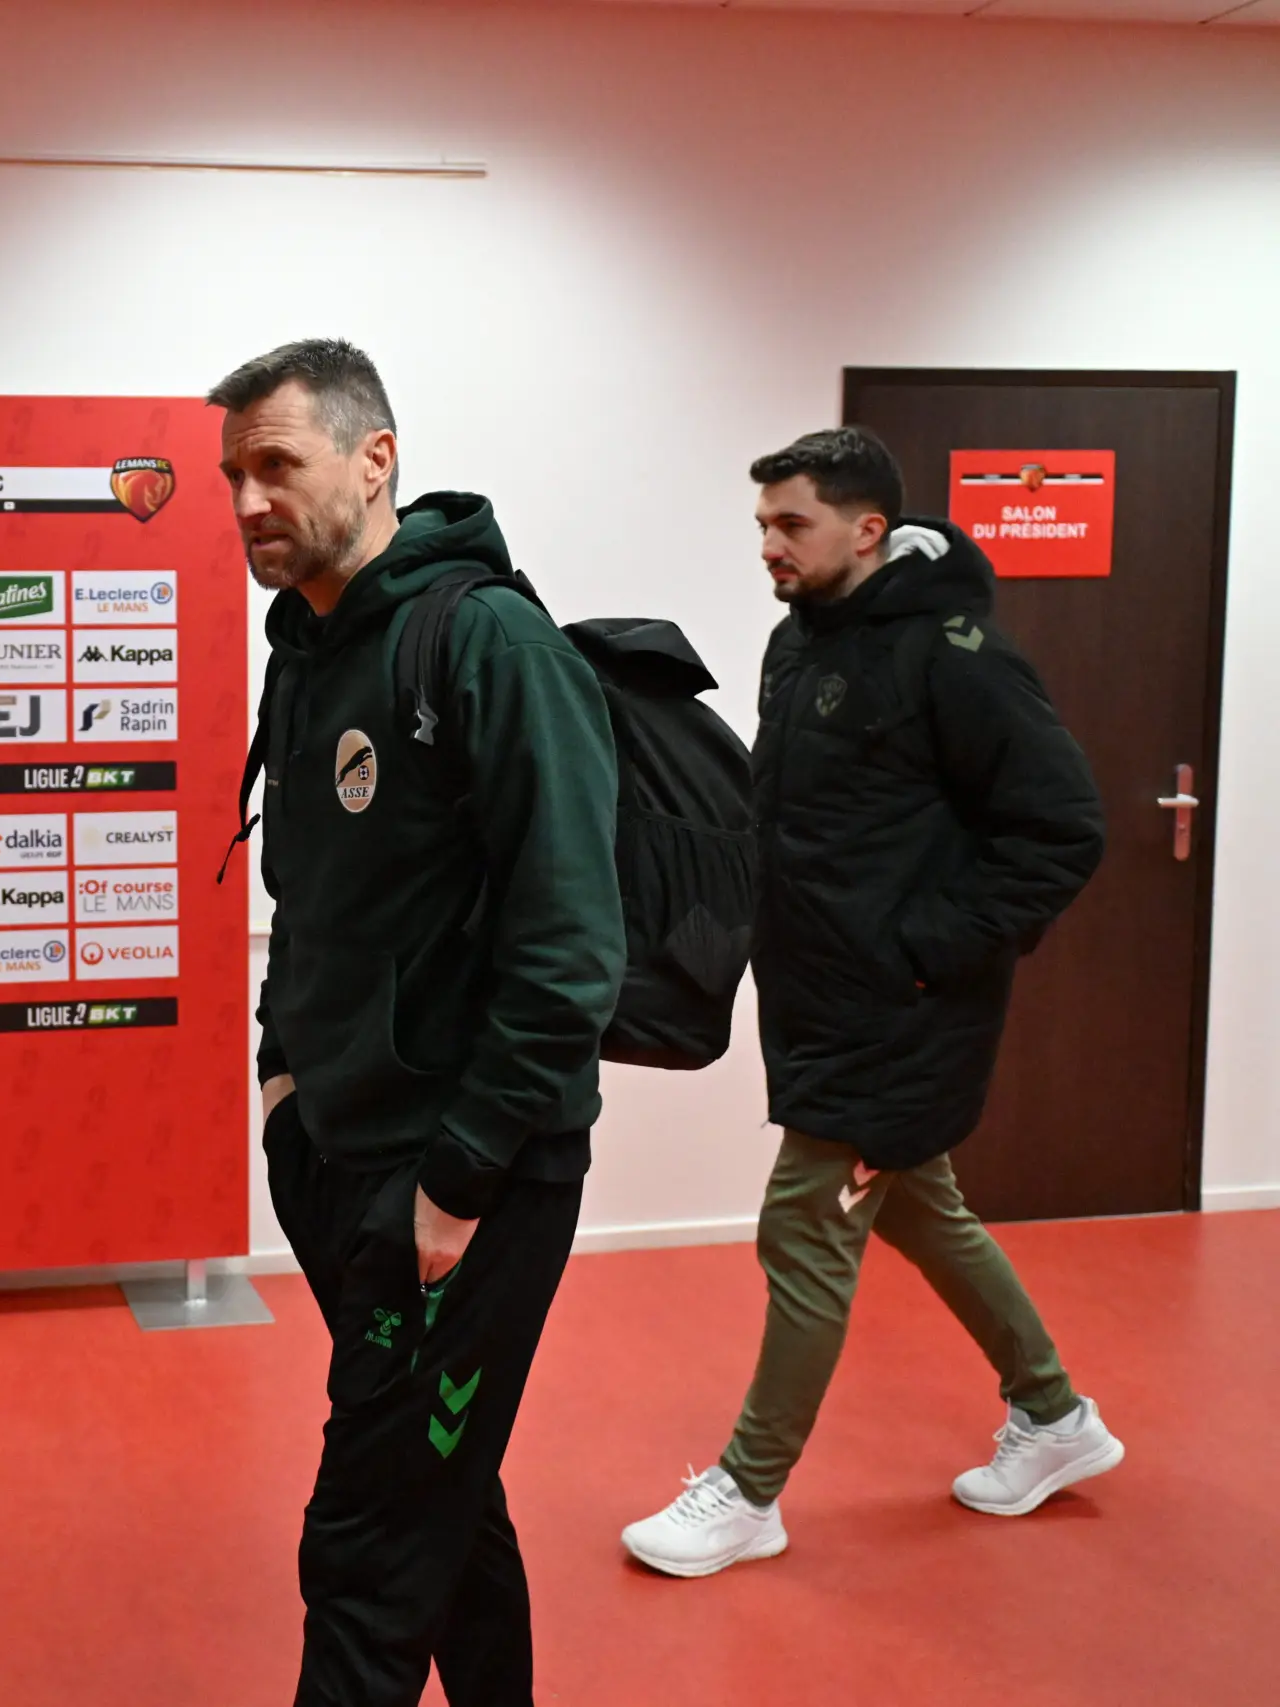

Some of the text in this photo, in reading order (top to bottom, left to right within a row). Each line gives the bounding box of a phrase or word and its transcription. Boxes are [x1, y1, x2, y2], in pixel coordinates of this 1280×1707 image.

[1001, 506, 1056, 520] SALON
[973, 525, 995, 538] DU
[75, 588, 148, 600] E.Leclerc
[98, 603, 148, 612] LE MANS
[111, 646, 173, 665] Kappa
[120, 700, 174, 715] Sadrin
[120, 717, 167, 733] Rapin
[24, 766, 135, 789] LIGUE 2 BKT
[341, 787, 370, 798] ASSE
[5, 830, 62, 849] dalkia
[106, 831, 174, 843] CREALYST
[113, 881, 173, 893] course
[1, 888, 64, 907] Kappa
[83, 893, 174, 912] LE MANS
[108, 946, 174, 959] VEOLIA
[6, 961, 42, 971] MANS
[27, 1003, 137, 1027] LIGUE 2 BKT
